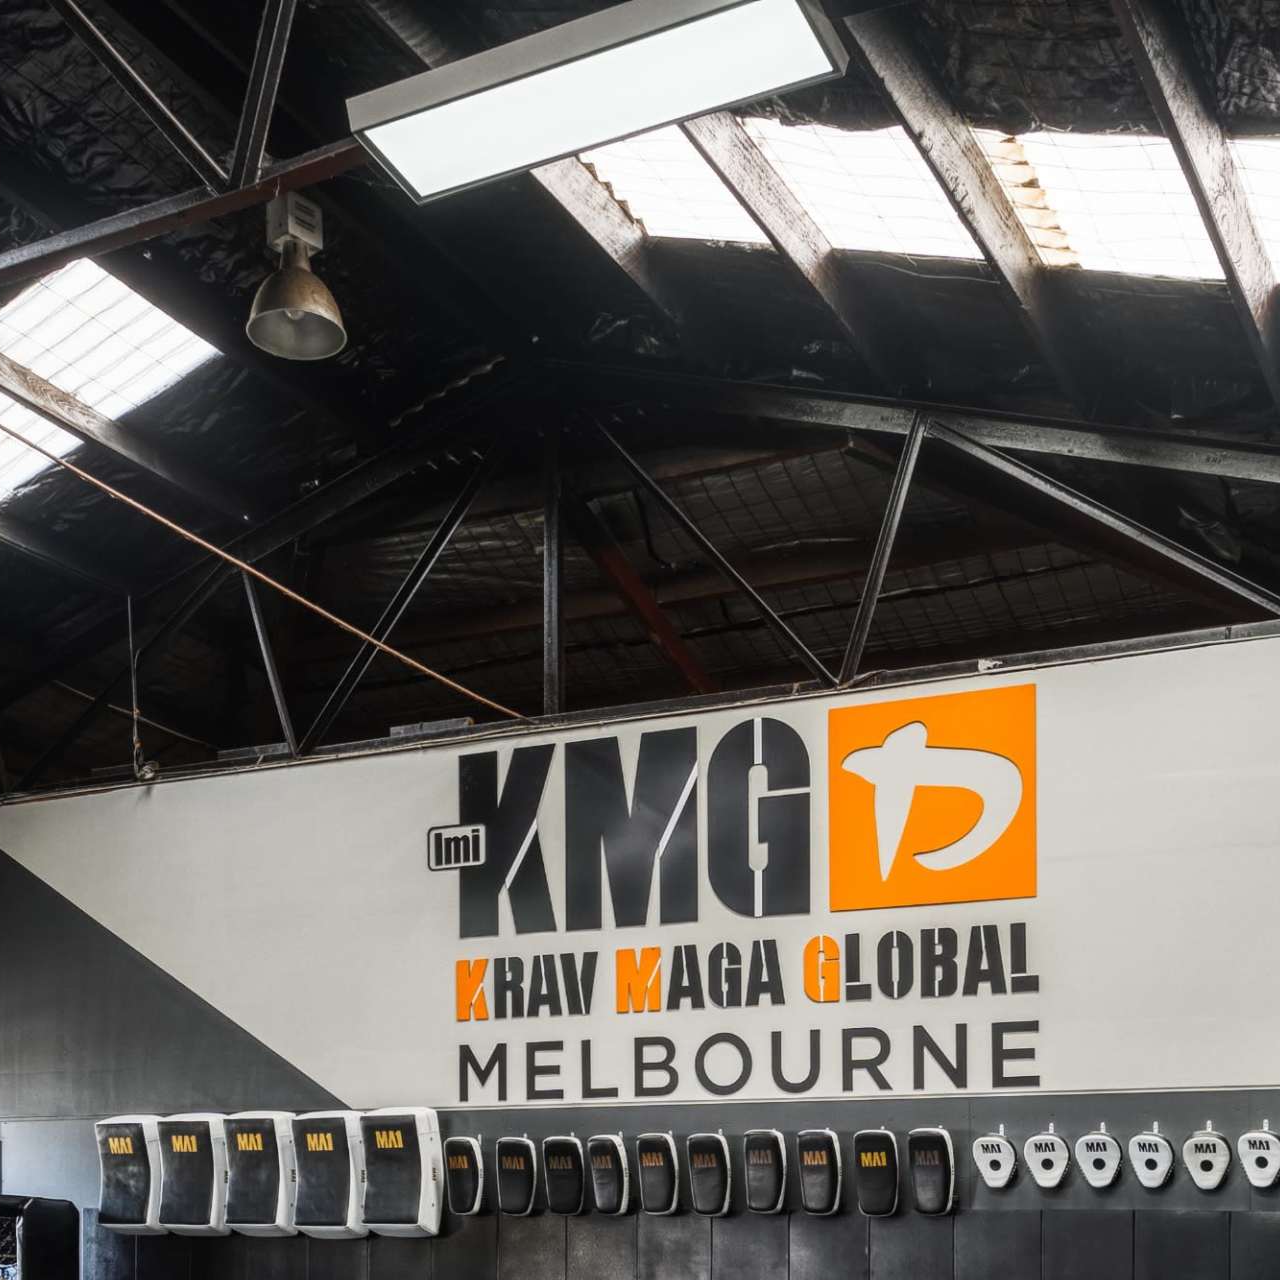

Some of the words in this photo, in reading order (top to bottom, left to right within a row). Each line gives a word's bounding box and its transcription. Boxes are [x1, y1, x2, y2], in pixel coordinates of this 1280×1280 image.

[458, 717, 811, 938] KMG
[456, 951, 598, 1022] KRAV
[616, 939, 785, 1013] MAGA
[804, 922, 1039, 1003] GLOBAL
[459, 1020, 1040, 1102] MELBOURNE
[109, 1136, 133, 1155] MA1
[172, 1134, 197, 1153] MA1
[237, 1133, 263, 1151] MA1
[306, 1133, 333, 1152] MA1
[375, 1130, 403, 1149] MA1
